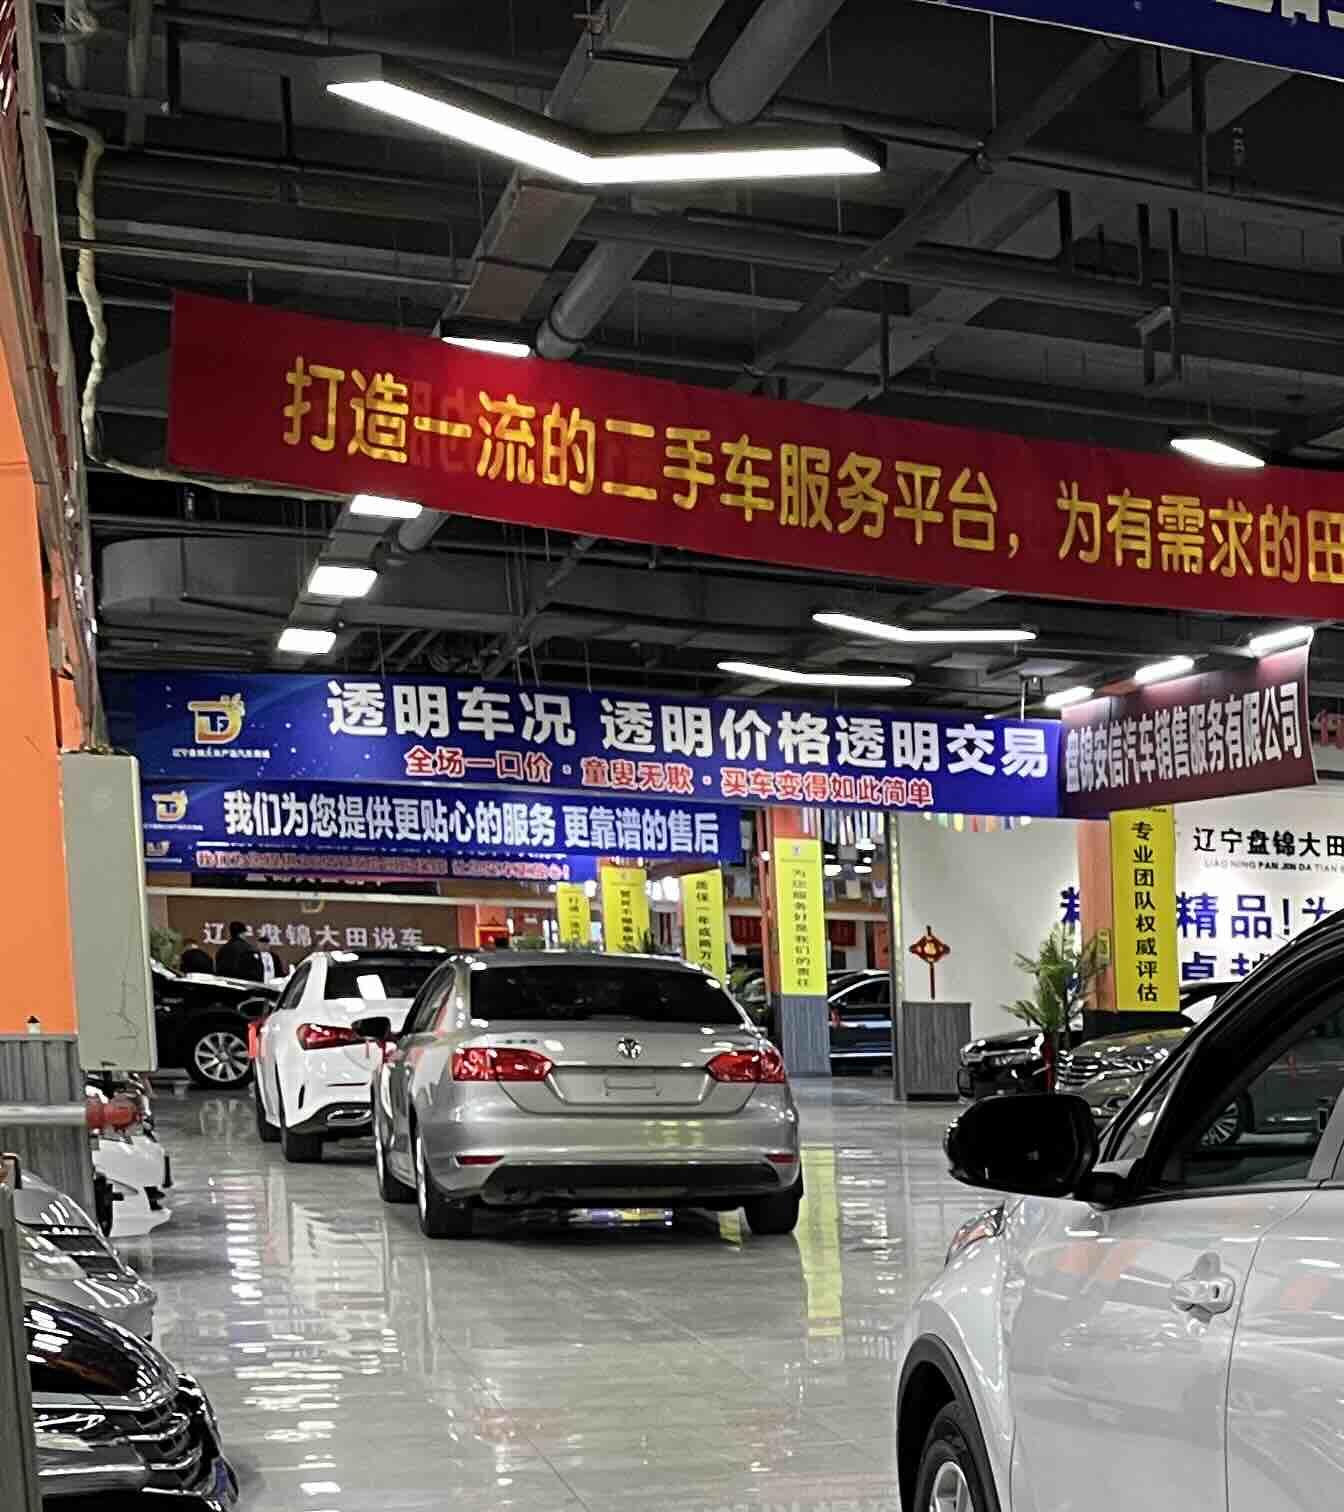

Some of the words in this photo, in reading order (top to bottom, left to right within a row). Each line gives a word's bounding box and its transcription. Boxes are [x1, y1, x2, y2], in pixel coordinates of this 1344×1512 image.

[327, 679, 576, 747] 透明车况
[600, 697, 1048, 778] 透明价格透明交易
[1065, 682, 1302, 793] 盘锦安信汽车销售服务有限公司
[223, 791, 556, 847] 我们为您提供更贴心的服务
[562, 804, 720, 854] 更靠谱的售后
[1258, 861, 1280, 871] PAN
[1299, 862, 1312, 872] DA
[1131, 821, 1158, 1003] 专业团队权威评估
